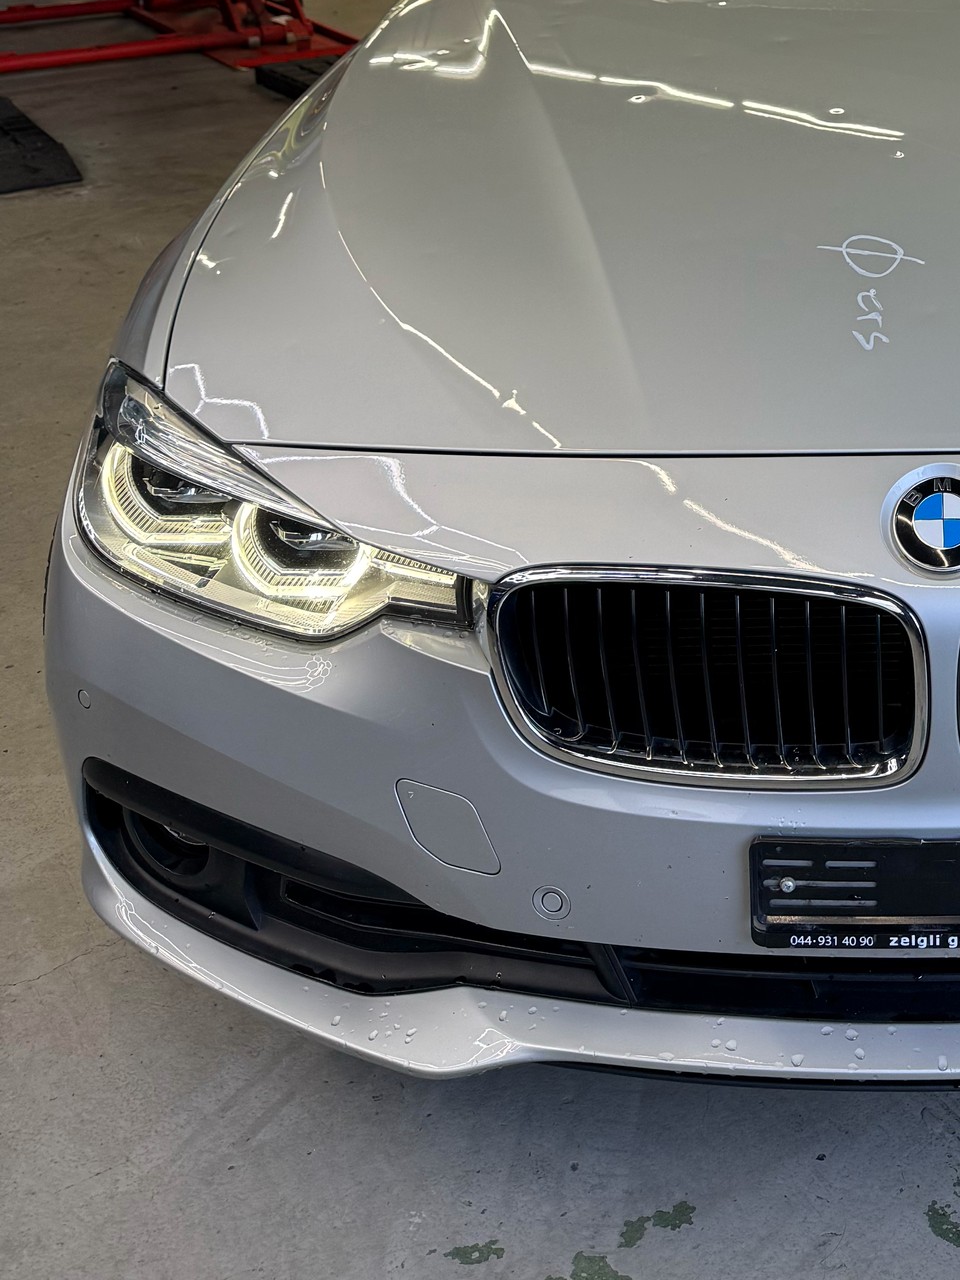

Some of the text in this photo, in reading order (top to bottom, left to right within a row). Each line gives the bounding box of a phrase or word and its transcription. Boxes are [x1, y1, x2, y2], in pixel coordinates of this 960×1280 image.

[842, 935, 857, 946] 40
[859, 936, 874, 947] 90
[889, 934, 941, 949] zelgli
